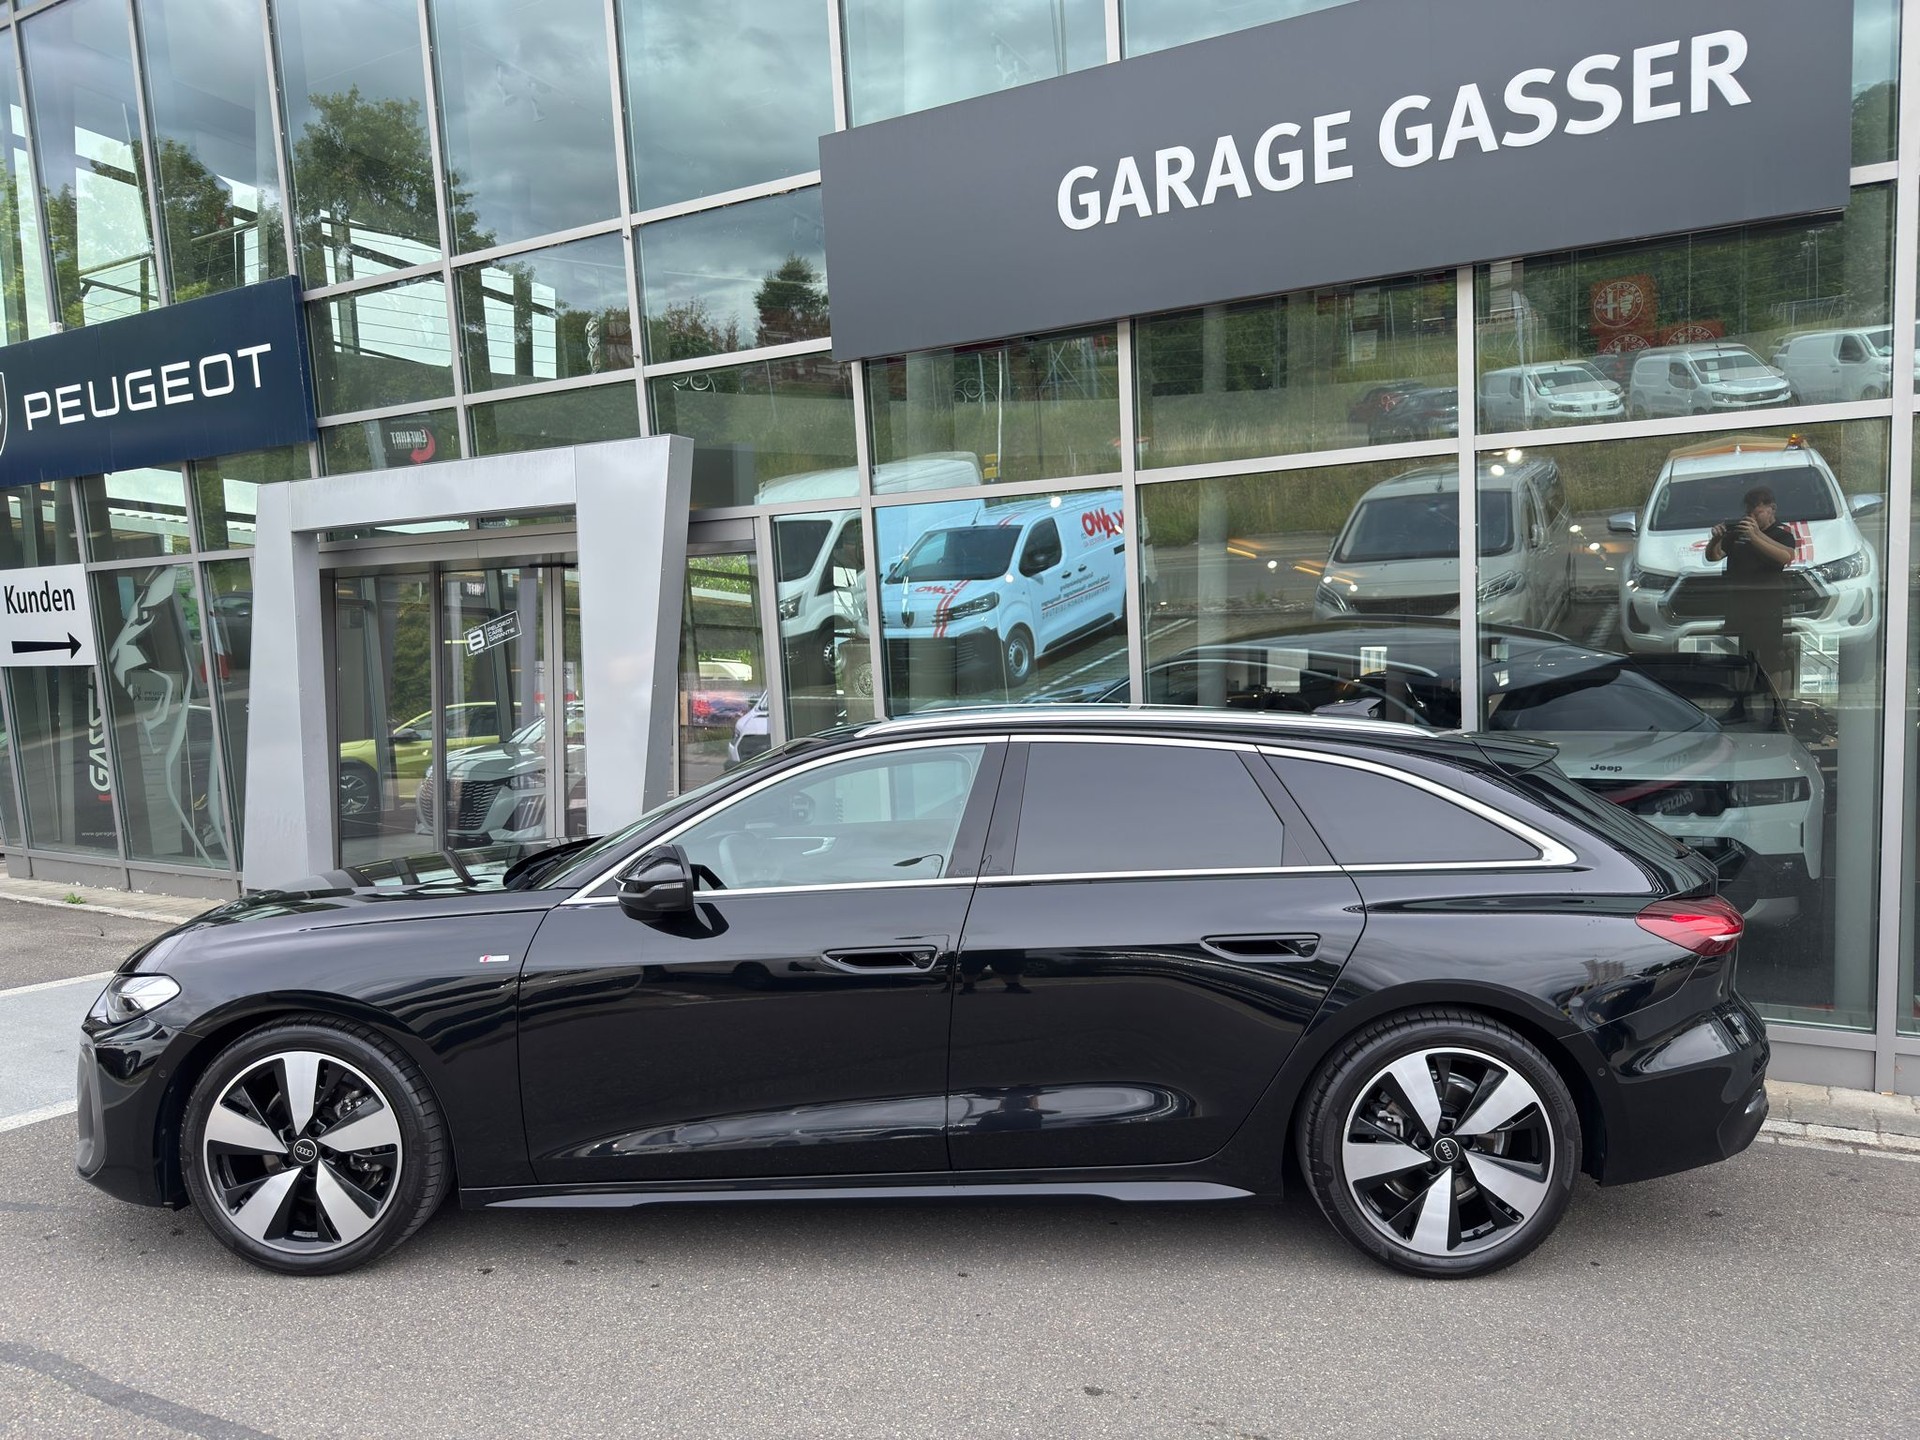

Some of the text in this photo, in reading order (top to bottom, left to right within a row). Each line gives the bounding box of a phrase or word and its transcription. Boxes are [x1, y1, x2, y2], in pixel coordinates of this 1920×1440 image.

[1057, 29, 1752, 230] GARAGE GASSER
[23, 343, 272, 431] PEUGEOT
[4, 580, 76, 614] Kunden
[468, 629, 486, 651] 8
[1590, 764, 1622, 772] Jeep
